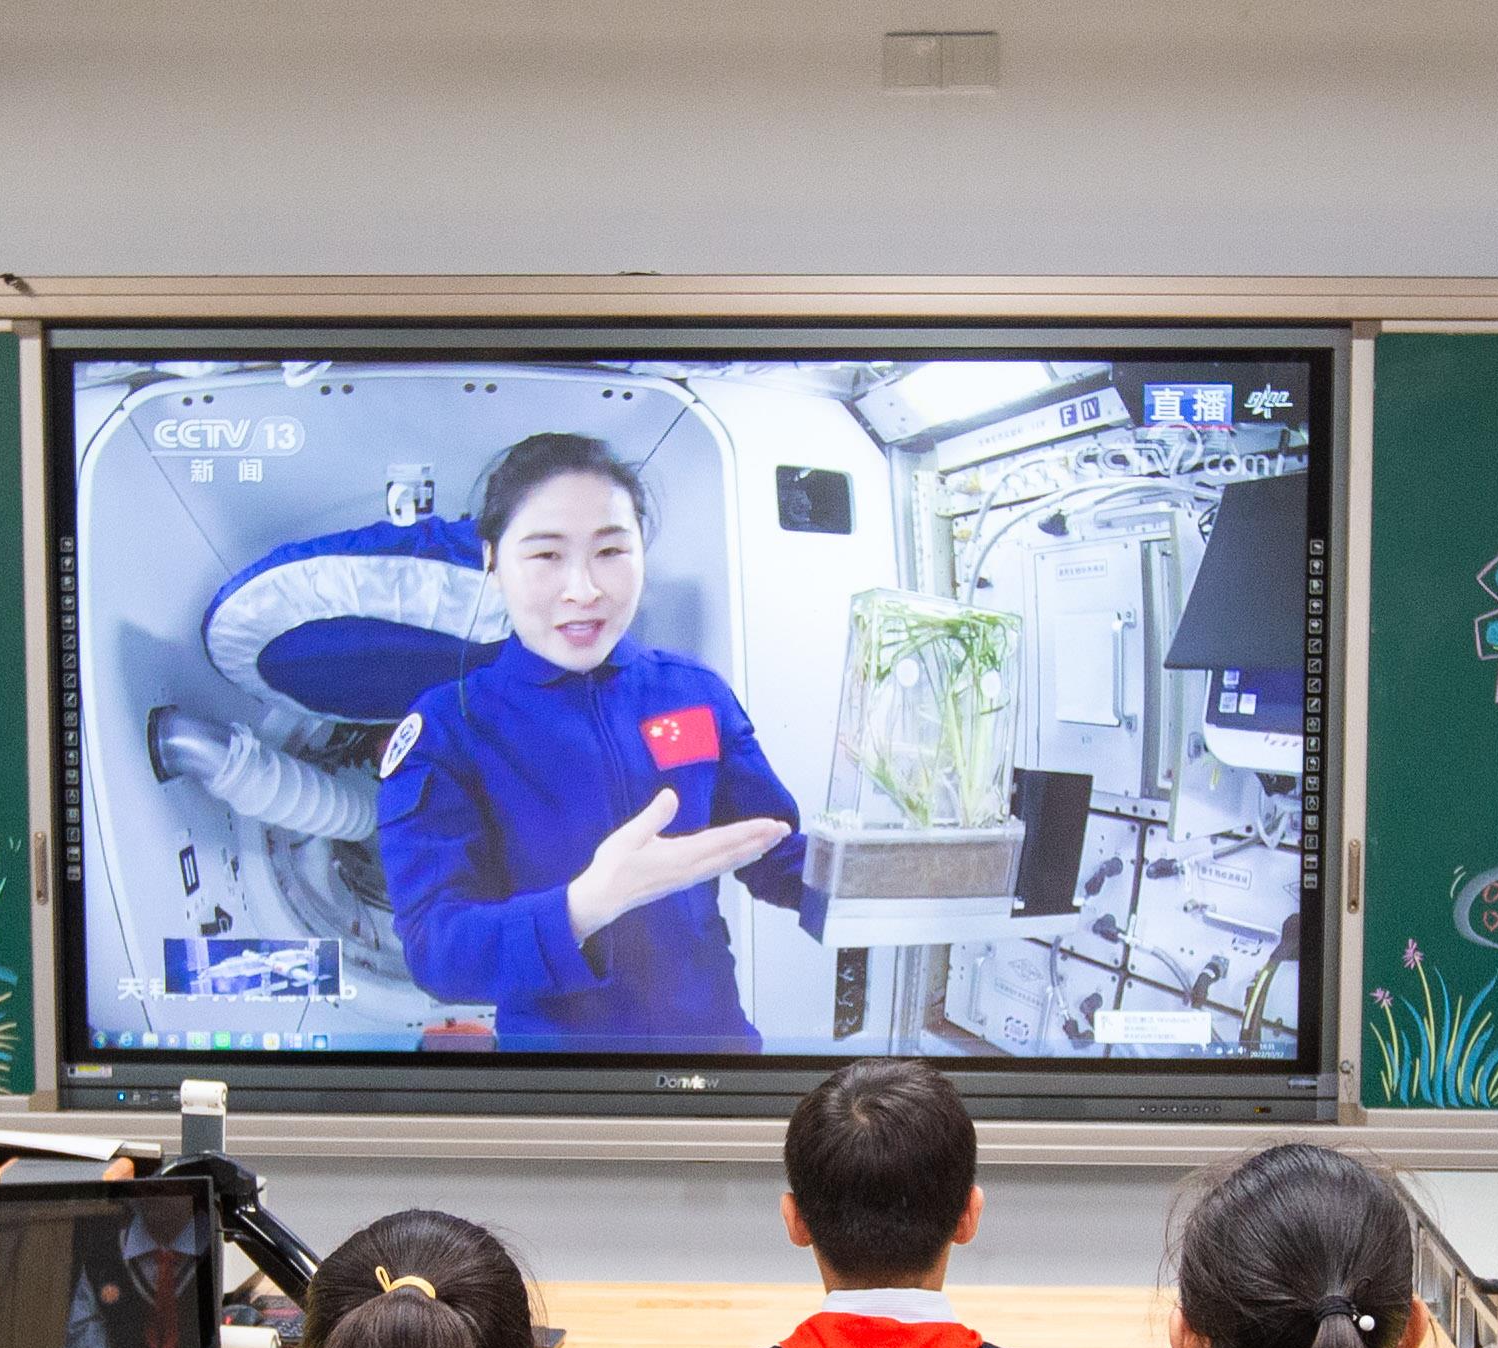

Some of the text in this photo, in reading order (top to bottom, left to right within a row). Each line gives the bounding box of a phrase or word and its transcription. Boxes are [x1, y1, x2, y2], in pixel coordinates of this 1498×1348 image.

[1150, 387, 1227, 422] 直播
[153, 418, 296, 450] CCTV 13
[189, 458, 264, 484] 新闻
